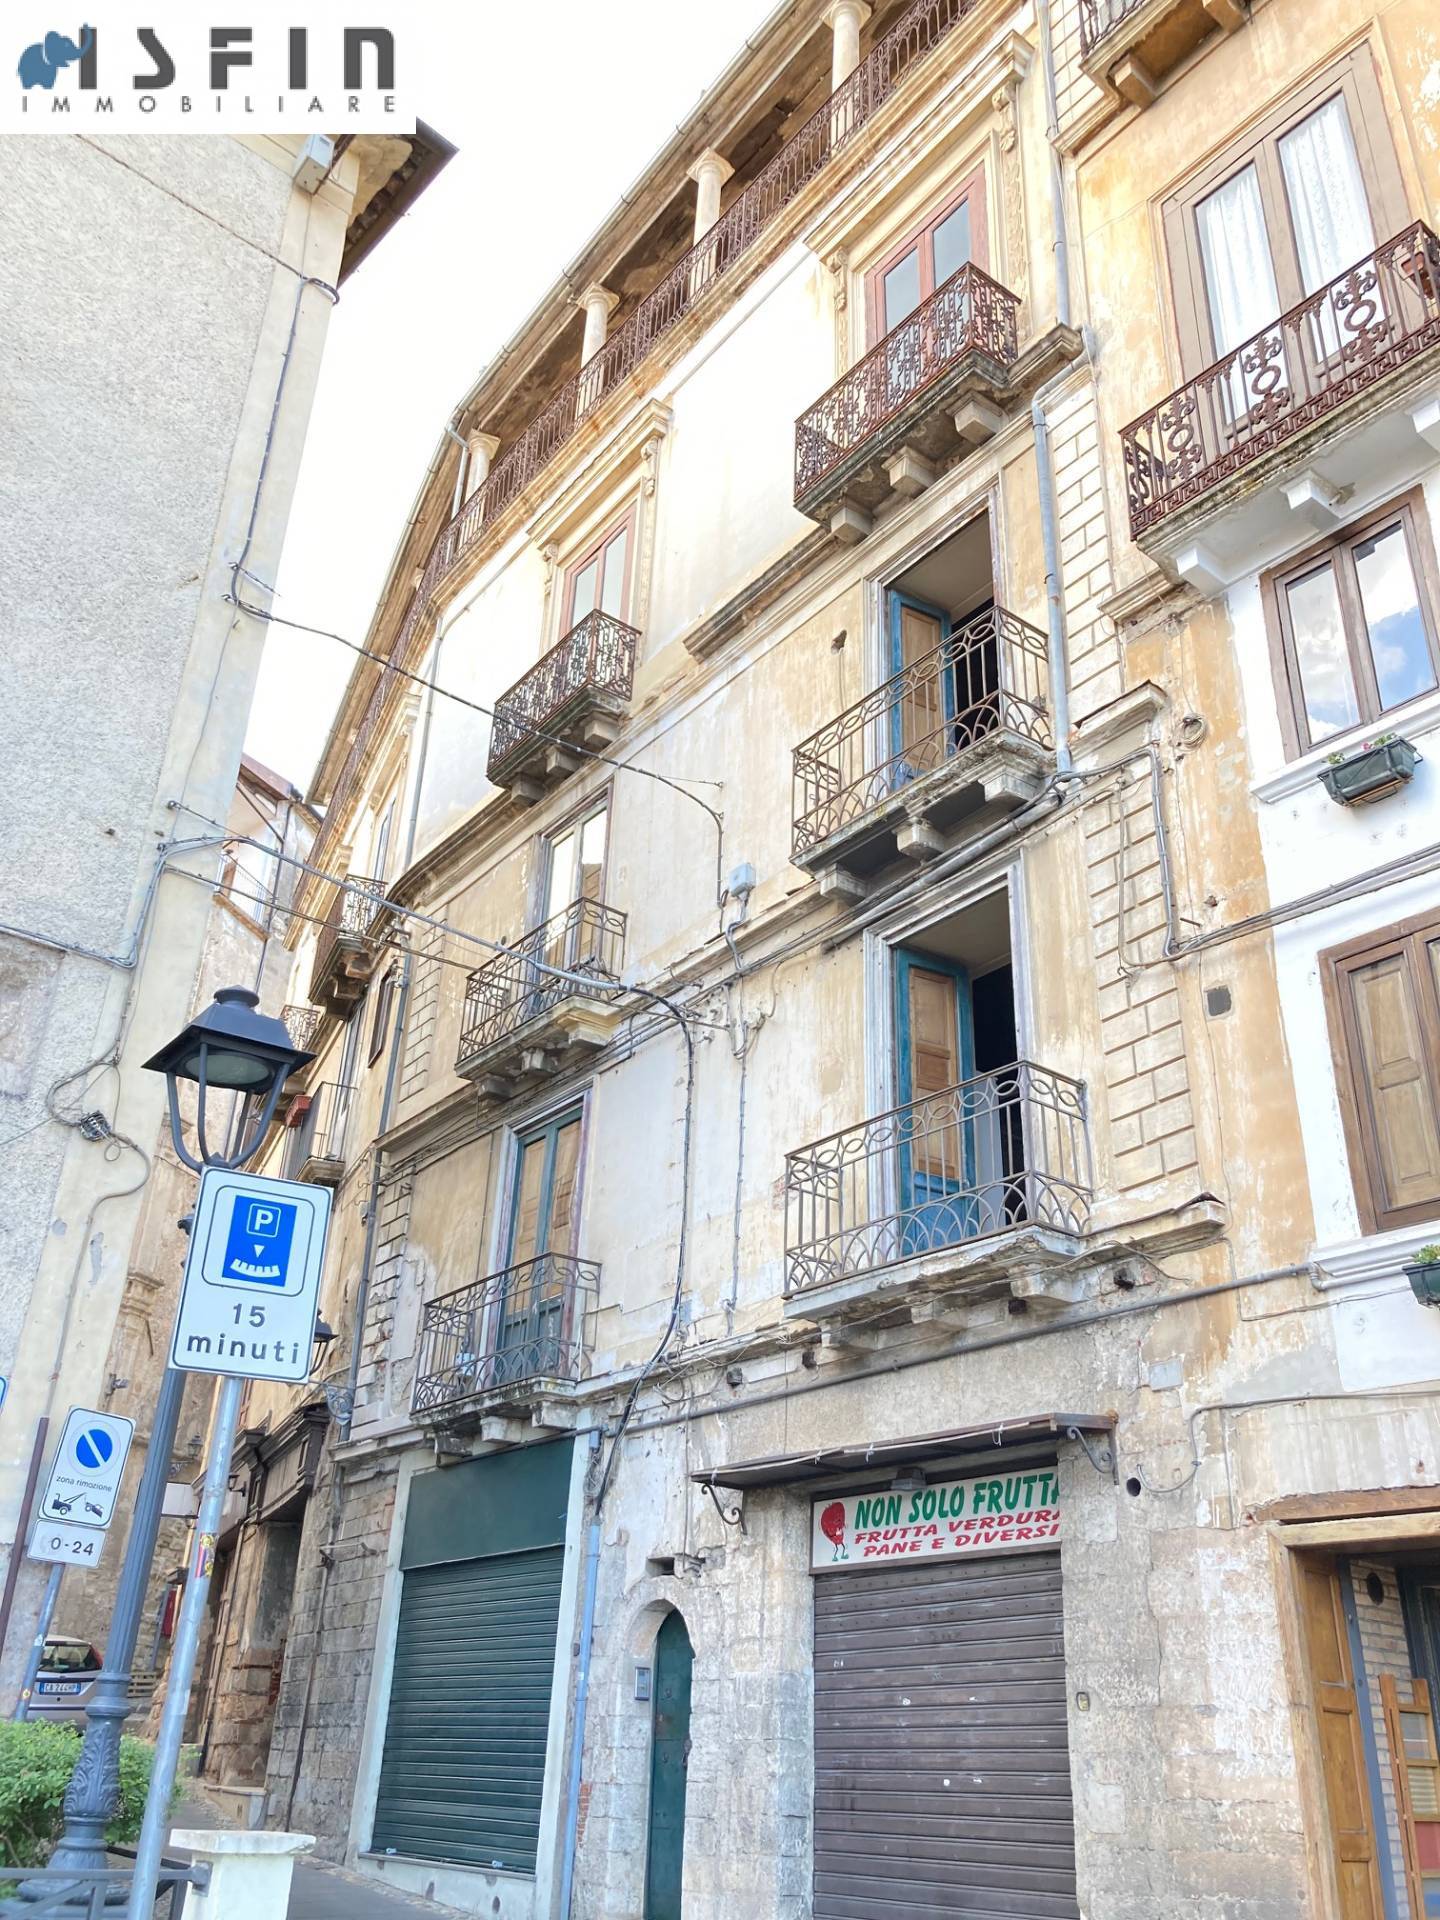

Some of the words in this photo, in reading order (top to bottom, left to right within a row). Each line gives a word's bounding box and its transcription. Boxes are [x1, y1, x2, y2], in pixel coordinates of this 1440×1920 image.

[255, 1209, 273, 1231] P
[233, 1303, 266, 1328] 15
[187, 1333, 299, 1364] minuti
[55, 1475, 75, 1485] zona
[76, 1479, 113, 1492] rimozione
[855, 1495, 903, 1530] NON
[909, 1485, 965, 1523] SOLO
[855, 1524, 938, 1545] FRUTTA
[864, 1542, 921, 1557] PANE
[931, 1537, 945, 1550] E
[955, 1524, 1060, 1547] DIVERSI
